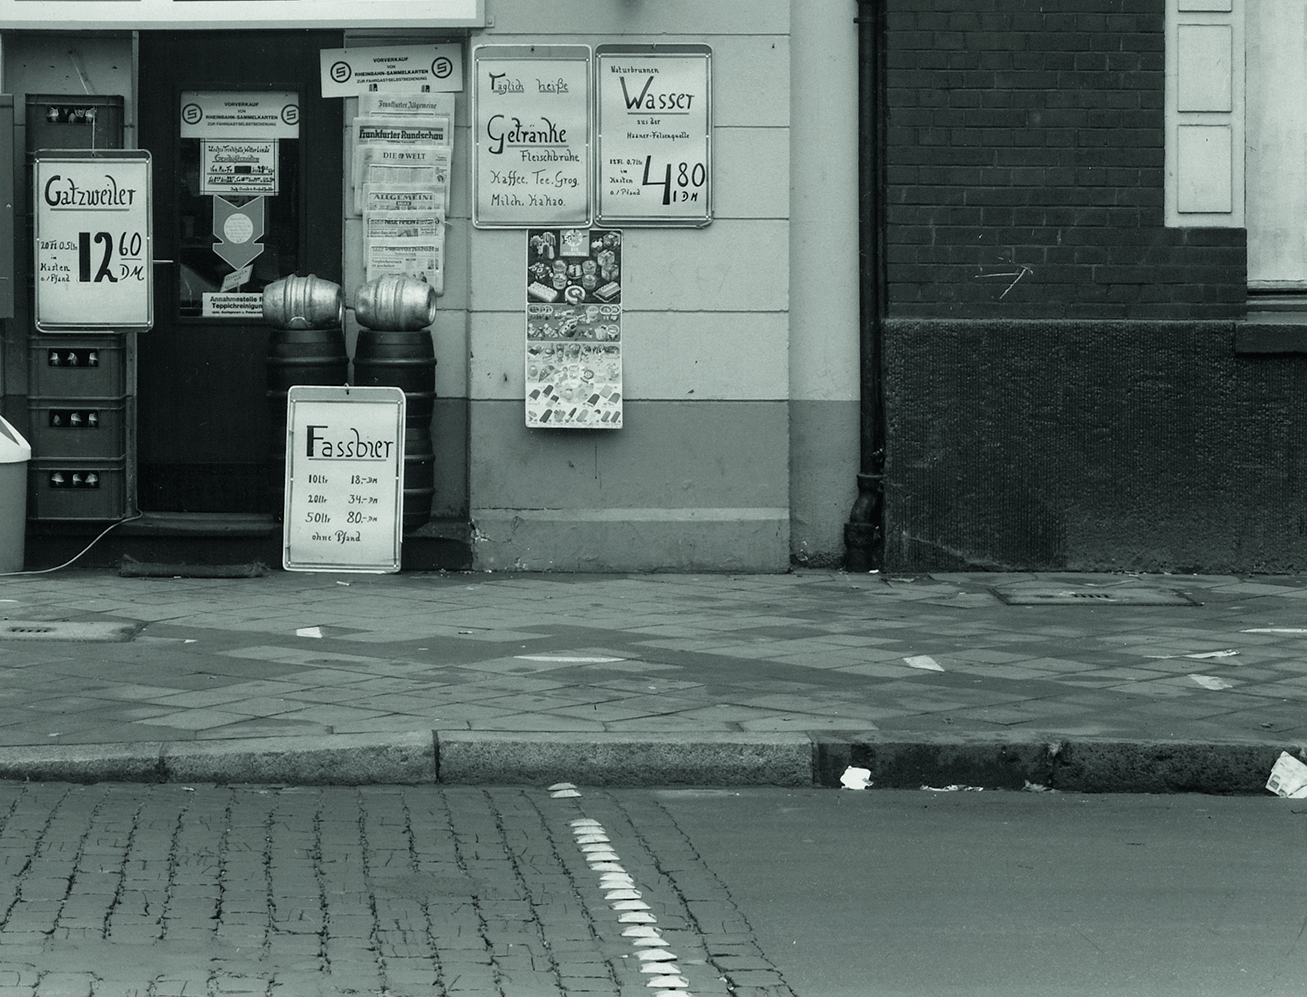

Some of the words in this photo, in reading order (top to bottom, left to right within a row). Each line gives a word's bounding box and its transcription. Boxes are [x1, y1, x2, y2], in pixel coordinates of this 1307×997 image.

[489, 72, 524, 95] Täglich
[536, 79, 569, 95] heiße
[619, 75, 694, 110] Wasser
[359, 130, 400, 139] Frankfurter
[401, 130, 443, 140] Rundschau
[487, 114, 566, 154] Getränke
[44, 174, 136, 206] Gatzweiler
[119, 264, 144, 281] DM
[306, 425, 393, 458] Fassbier
[312, 532, 331, 541] ohne
[335, 530, 361, 544] Pfand
